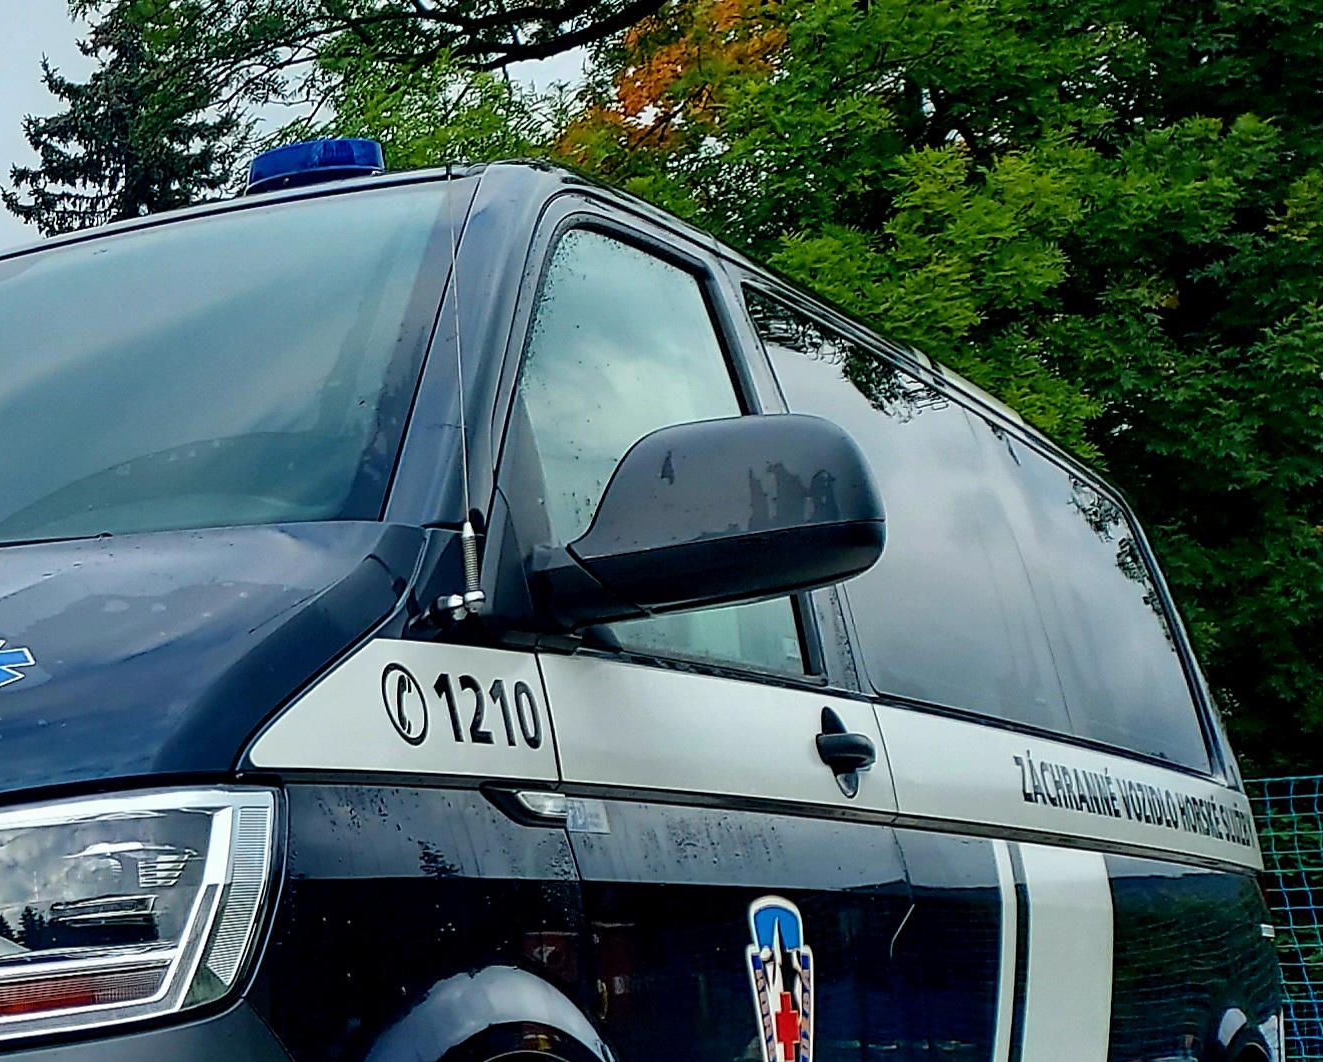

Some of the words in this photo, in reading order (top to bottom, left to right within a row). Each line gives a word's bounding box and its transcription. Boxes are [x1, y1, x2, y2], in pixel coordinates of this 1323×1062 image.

[434, 673, 542, 749] 1210
[1013, 749, 1121, 818] ZÁCHRANNÉ
[1116, 778, 1179, 830] VOZIDLO
